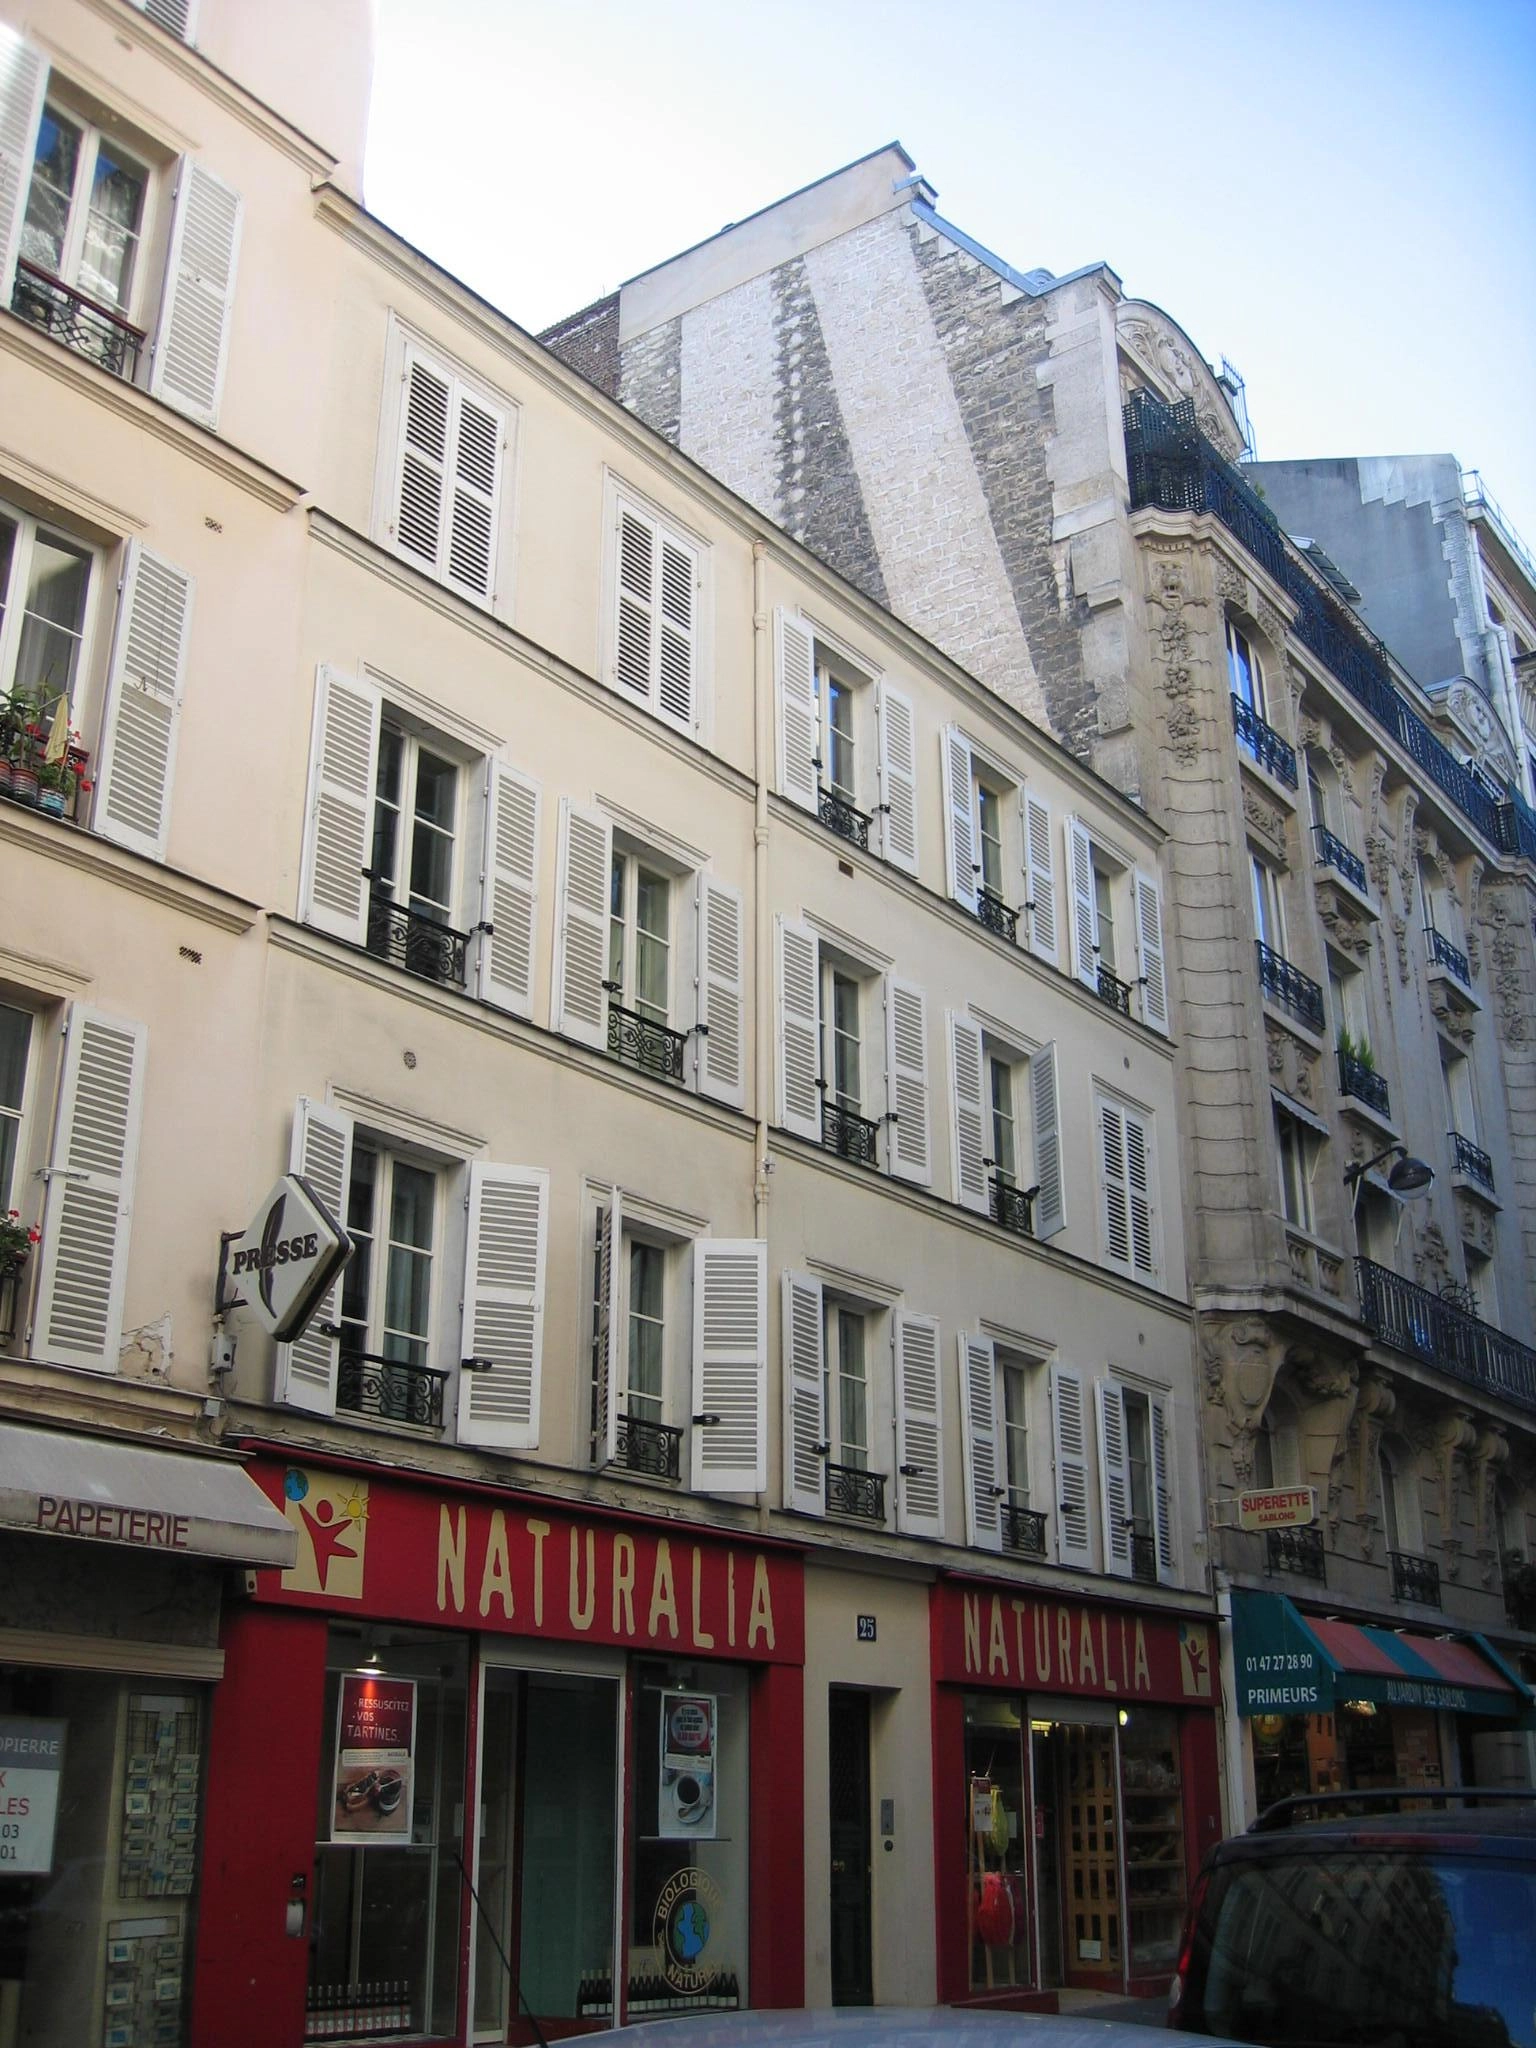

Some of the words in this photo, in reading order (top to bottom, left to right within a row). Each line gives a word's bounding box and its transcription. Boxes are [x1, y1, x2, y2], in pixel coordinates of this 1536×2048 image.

[233, 1233, 319, 1275] PRESSE
[1241, 1492, 1310, 1513] SUPERETTE
[37, 1496, 189, 1547] PAPETERIE
[1258, 1511, 1297, 1523] SABLONS
[437, 1503, 776, 1650] NATURALIA
[860, 1617, 875, 1638] 25
[964, 1592, 1151, 1692] NATURALIA
[1246, 1656, 1258, 1672] 01
[1259, 1655, 1271, 1671] 47
[1272, 1655, 1285, 1671] 27
[1300, 1653, 1313, 1669] 90
[1248, 1686, 1318, 1705] PRIMEURS
